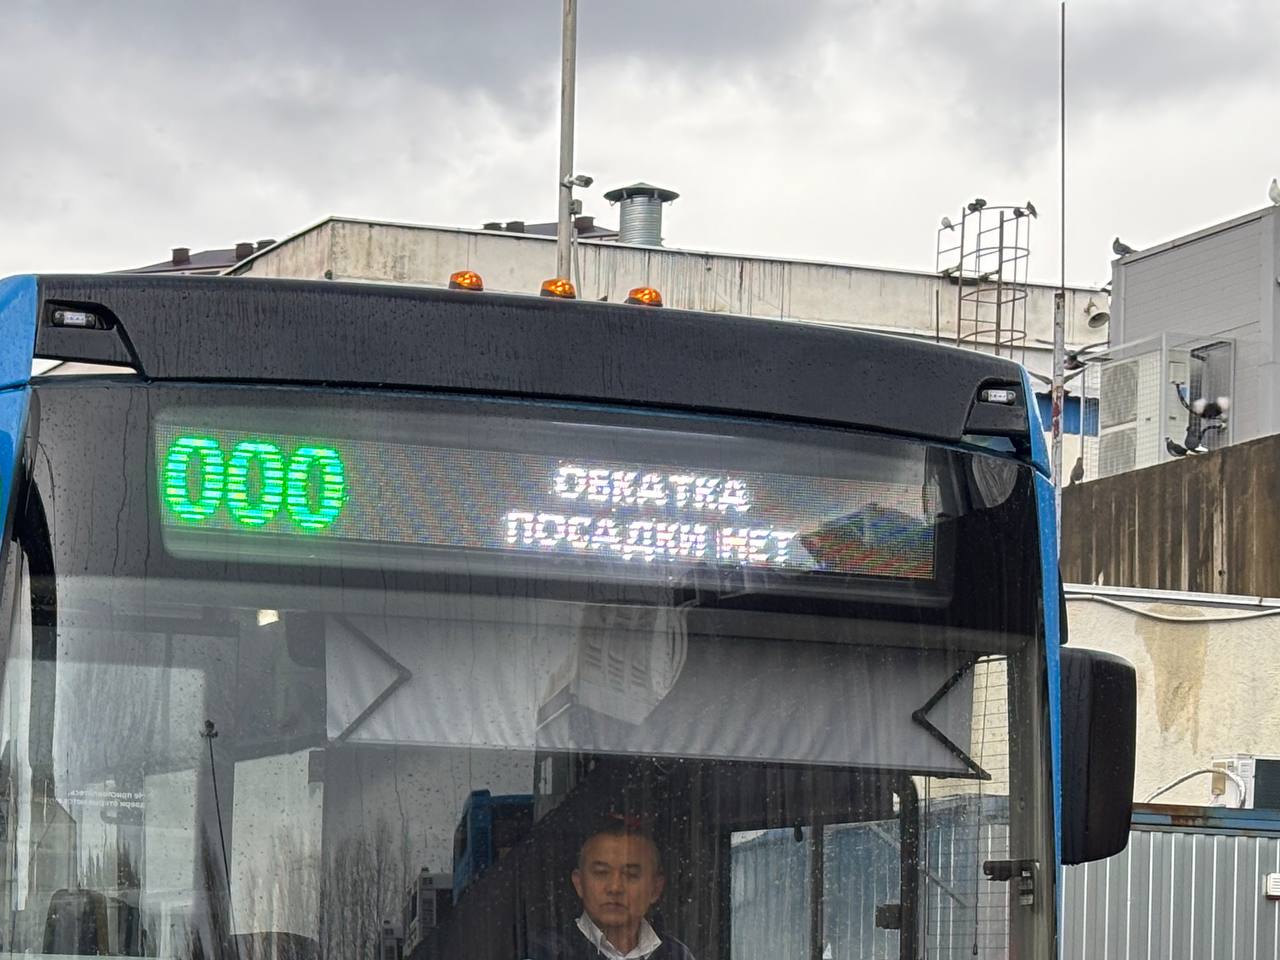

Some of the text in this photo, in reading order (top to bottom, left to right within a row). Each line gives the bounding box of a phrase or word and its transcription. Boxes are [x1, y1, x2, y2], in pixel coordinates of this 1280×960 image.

[164, 435, 345, 531] 000
[553, 465, 752, 512] ОБКАТКА
[505, 511, 798, 563] ПОСАДКИ НЕТ
